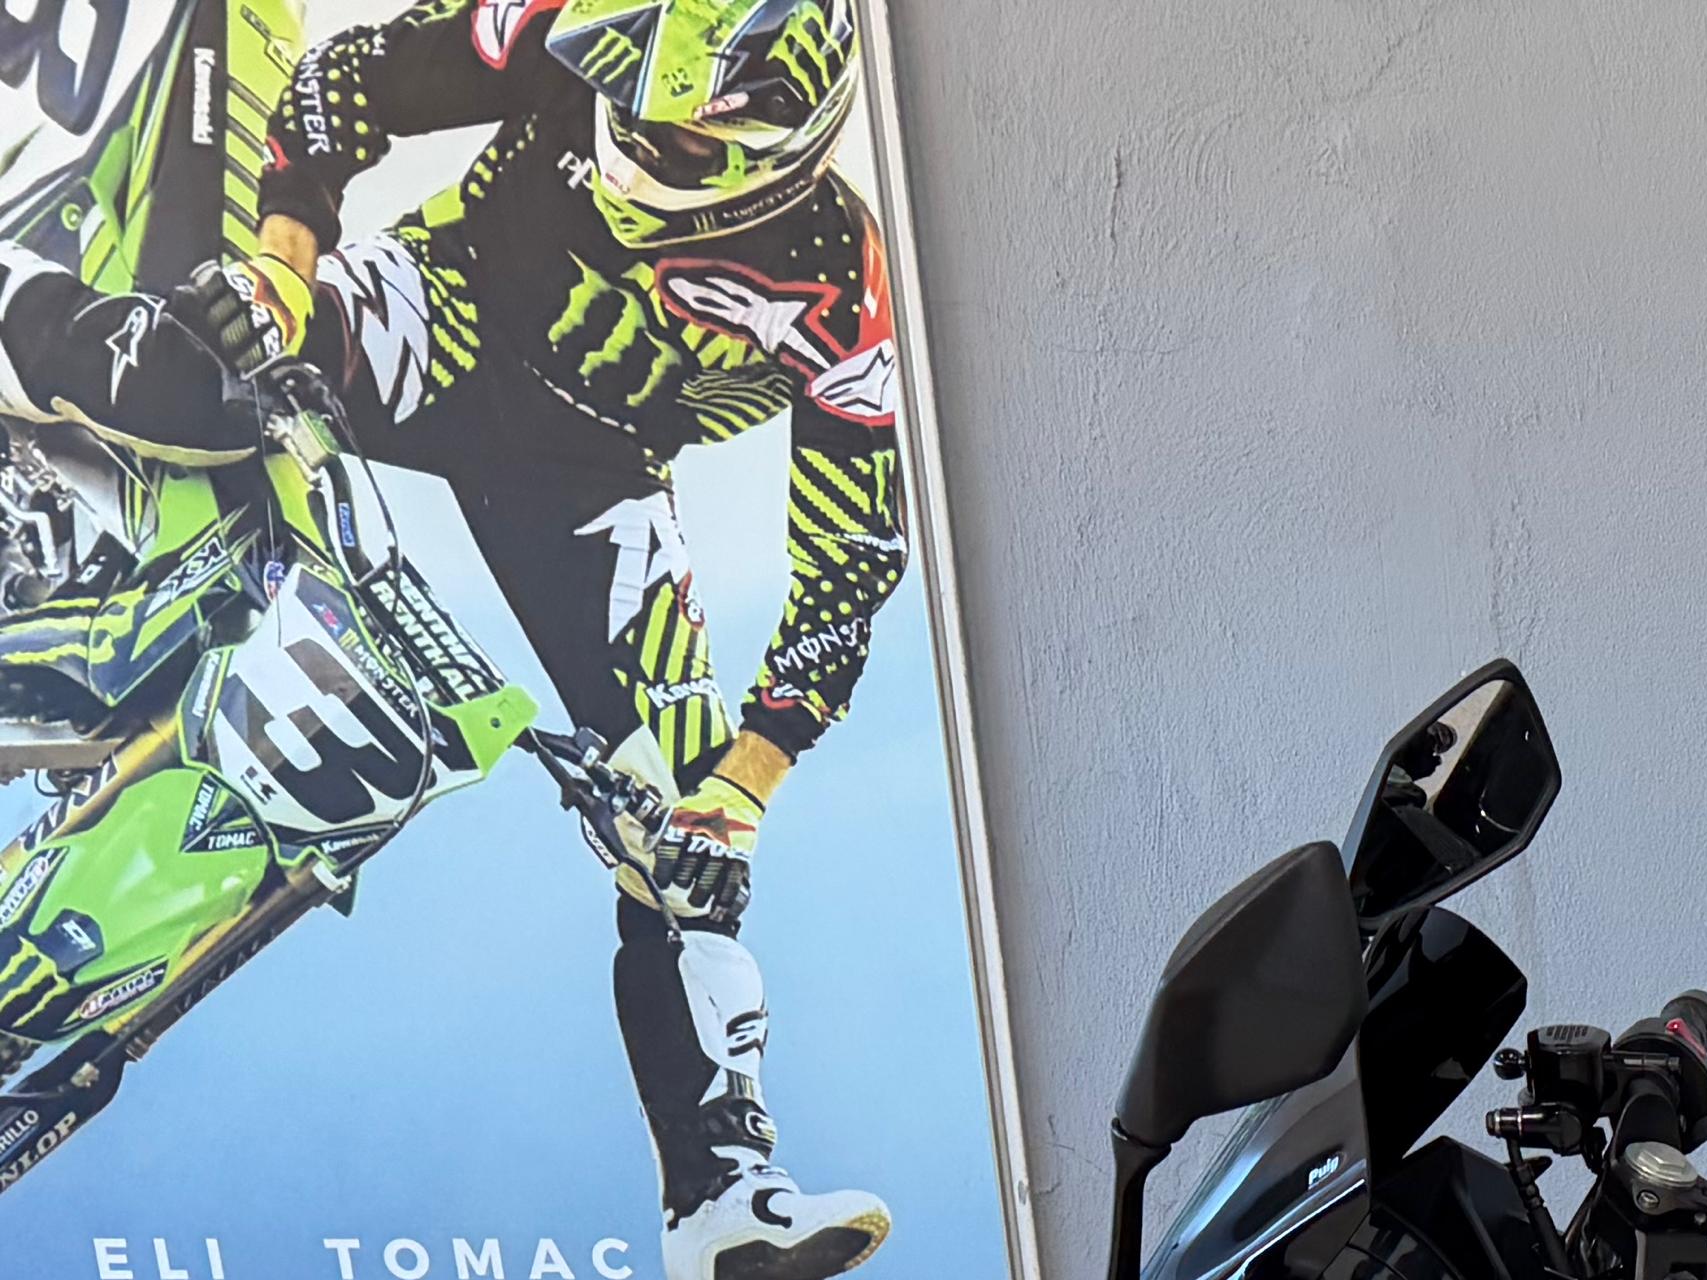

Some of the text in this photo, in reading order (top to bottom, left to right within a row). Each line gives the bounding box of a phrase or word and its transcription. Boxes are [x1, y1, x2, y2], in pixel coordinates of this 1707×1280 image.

[294, 40, 332, 156] ONSTER
[207, 831, 257, 850] TOMAC
[93, 1237, 225, 1280] ELI
